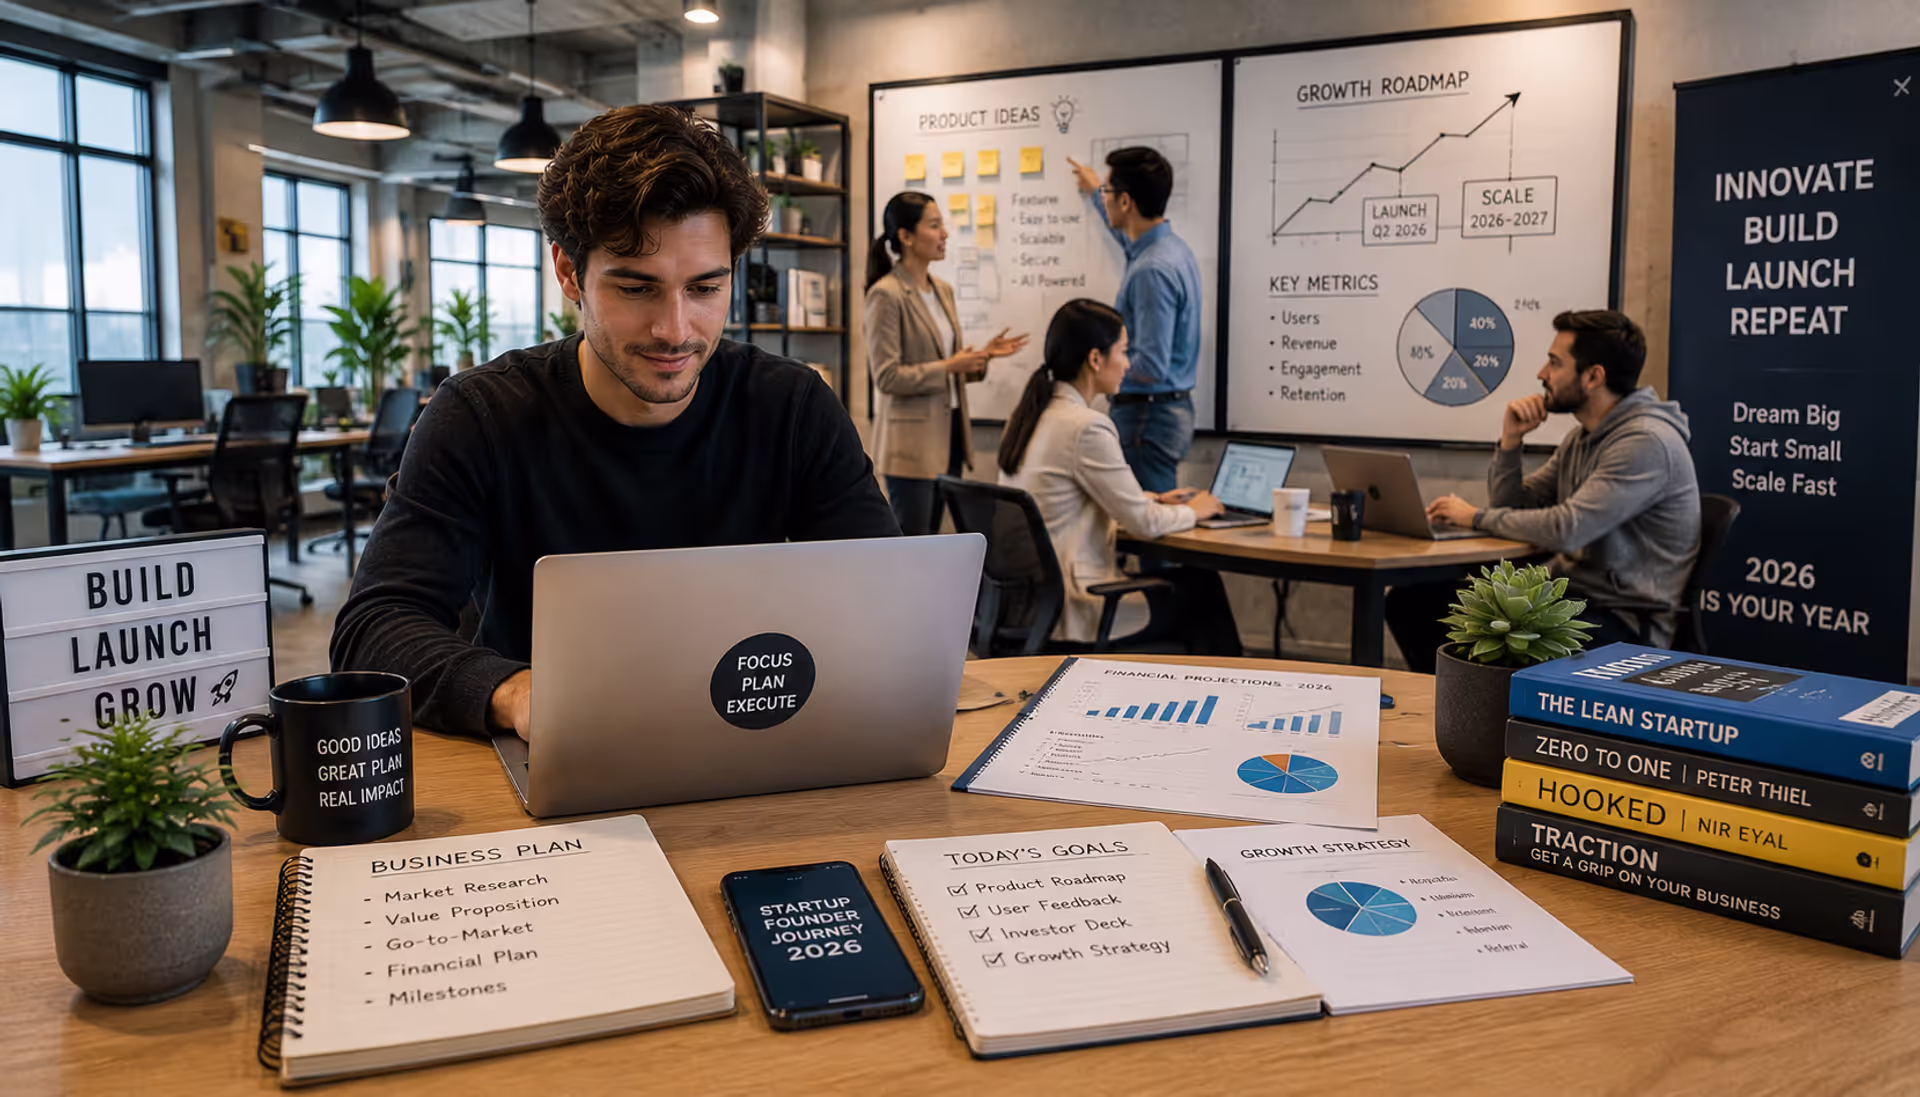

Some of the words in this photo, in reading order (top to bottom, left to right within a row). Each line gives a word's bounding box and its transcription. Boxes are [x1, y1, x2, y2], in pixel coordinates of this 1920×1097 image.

[1297, 80, 1371, 102] GROWTH
[1382, 71, 1469, 94] ROADMAP
[919, 110, 987, 129] PRODUCT
[995, 106, 1040, 124] IDEAS
[1716, 159, 1874, 201] INNOVATE
[1482, 188, 1534, 205] SCALE
[1373, 204, 1427, 219] LAUNCH
[1471, 212, 1548, 228] 2026-2027
[1372, 225, 1390, 238] Q2
[1395, 225, 1427, 237] 2026
[1745, 212, 1838, 244] BUILD
[1270, 276, 1300, 291] KEY
[1307, 275, 1379, 291] METRICS
[1726, 258, 1855, 290] LAUNCH
[1282, 312, 1320, 325] Users
[1731, 306, 1848, 335] REPEAT
[1282, 336, 1337, 350] Revenue
[1281, 362, 1361, 379] Engagement
[1281, 386, 1345, 401] Retention
[1733, 402, 1799, 424] Dream
[1806, 404, 1840, 431] Big
[1729, 435, 1778, 458] Start
[1785, 438, 1841, 461] Small
[1732, 469, 1786, 492] Scale
[1792, 473, 1837, 497] Fast
[86, 562, 195, 609] BUILD
[1745, 557, 1815, 589] 2026
[1700, 589, 1720, 612] IS
[1728, 593, 1794, 624] YOUR
[1802, 603, 1869, 635] YEAR
[71, 616, 212, 674] LAUNCH
[737, 652, 793, 670] FOCUS
[741, 674, 785, 692] PLAN
[1104, 669, 1177, 680] FINANCIAL
[1184, 675, 1282, 687] PROJECTIONS
[1298, 683, 1333, 691] 2026
[95, 676, 196, 729] GROW
[726, 694, 797, 714] EXECUTE
[1538, 692, 1575, 715] THE
[1581, 702, 1634, 728] LEAN
[1640, 711, 1739, 745] STARTUP
[317, 737, 361, 755] GOOD
[366, 728, 402, 751] IDEAS
[318, 762, 366, 781] GREAT
[371, 753, 402, 776] PLAN
[1535, 736, 1588, 762] ZERO
[1595, 747, 1621, 768] TO
[1628, 754, 1672, 780] ONE
[1696, 769, 1752, 795] PETER
[1759, 782, 1812, 807] THIEL
[320, 790, 357, 807] REAL
[361, 778, 404, 803] IMPACT
[1538, 778, 1666, 826] HOOKED
[1698, 817, 1731, 838] NIR
[1738, 826, 1788, 851] EYAL
[371, 848, 502, 873] BUSINESS
[516, 839, 582, 856] PLAN
[944, 847, 1042, 865] TODAY'S
[1052, 841, 1128, 856] GOALS
[1240, 844, 1317, 860] GROWTH
[1322, 838, 1411, 854] STRATEGY
[1531, 823, 1659, 872] TRACTION
[385, 885, 454, 903] Market
[464, 874, 548, 894] Research
[976, 878, 1043, 894] Product
[1051, 872, 1126, 888] Roadmap
[1530, 847, 1559, 865] GET
[1562, 854, 1573, 869] A
[1578, 858, 1614, 878] GRIP
[1618, 868, 1642, 886] ON
[1646, 875, 1691, 899] YOUR
[1696, 888, 1781, 920] BUSINESS
[385, 911, 440, 925] Value
[451, 896, 559, 919] Proposition
[760, 897, 850, 916] STARTUP
[988, 903, 1029, 916] User
[1039, 893, 1121, 912] Feedback
[764, 910, 860, 930] FOUNDER
[1000, 922, 1076, 940] Investor
[1085, 916, 1132, 931] Deck
[386, 922, 534, 951] Go-to-Market
[771, 924, 863, 945] JOURNEY
[388, 954, 482, 978] Financial
[493, 948, 538, 964] Plan
[787, 940, 862, 961] 2026
[1015, 947, 1083, 965] Growth
[1090, 939, 1170, 958] Strategy
[388, 981, 507, 1007] Milestones
